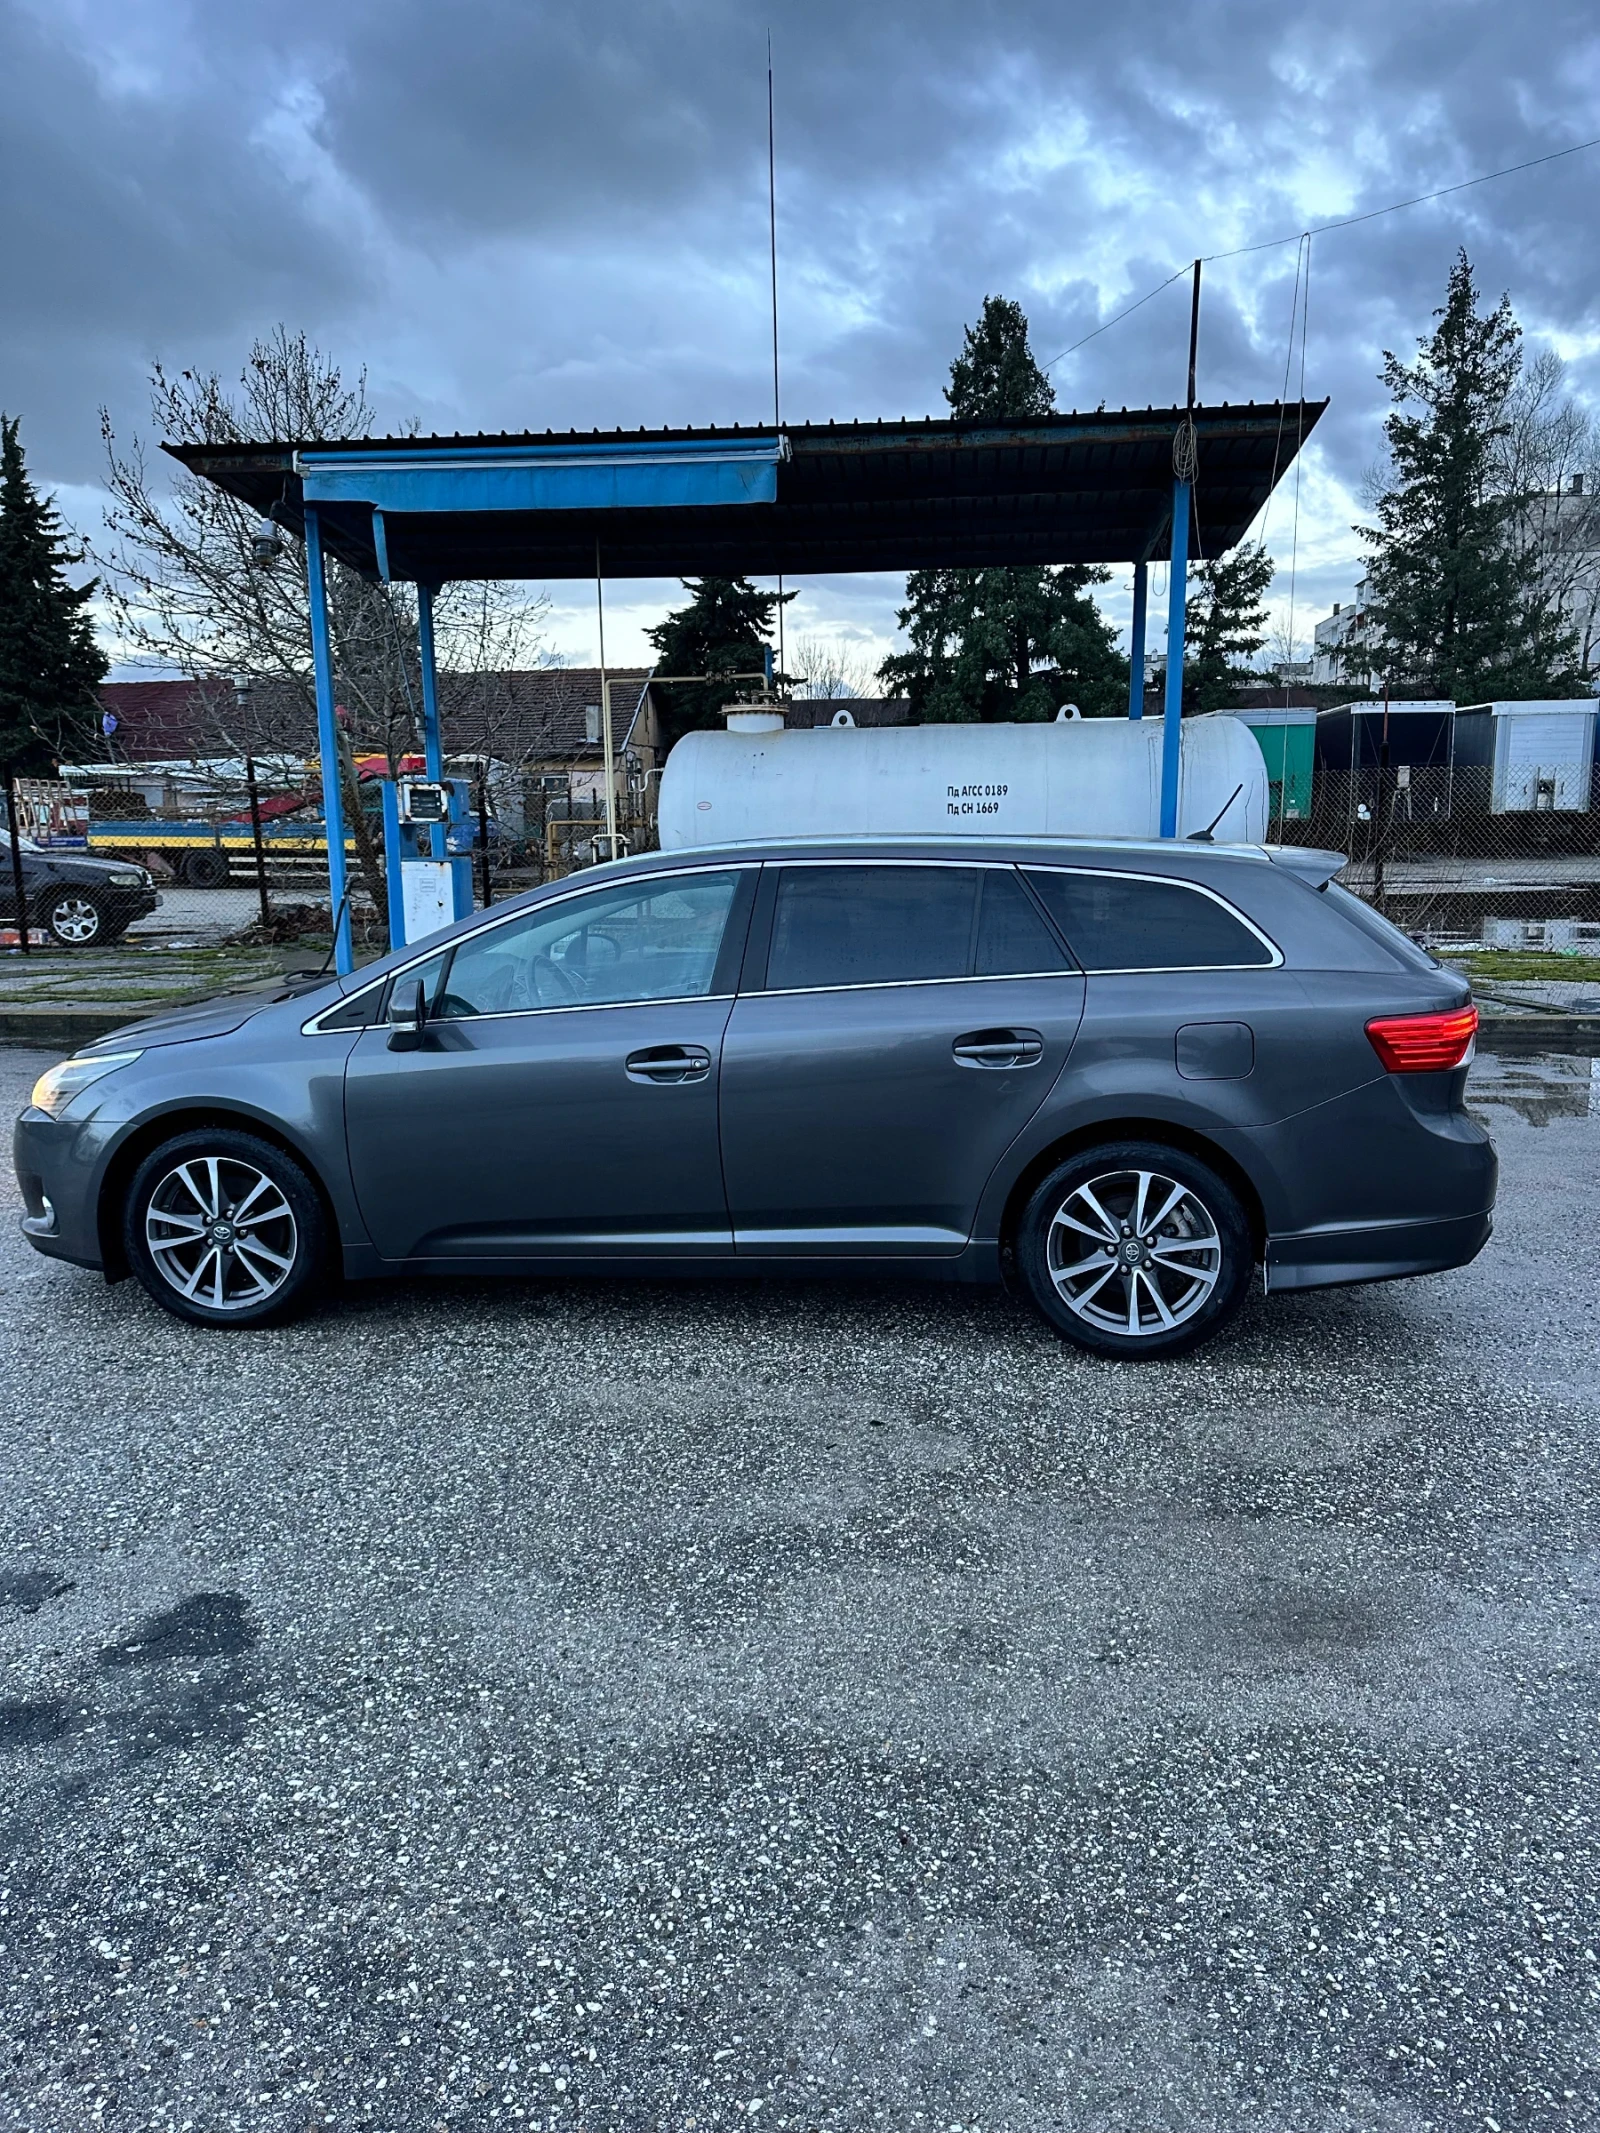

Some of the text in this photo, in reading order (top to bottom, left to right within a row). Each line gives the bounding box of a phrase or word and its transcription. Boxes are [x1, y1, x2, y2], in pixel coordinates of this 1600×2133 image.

[947, 784, 1008, 798] Пд АГСС 0189
[947, 802, 999, 816] Пд СН 1669
